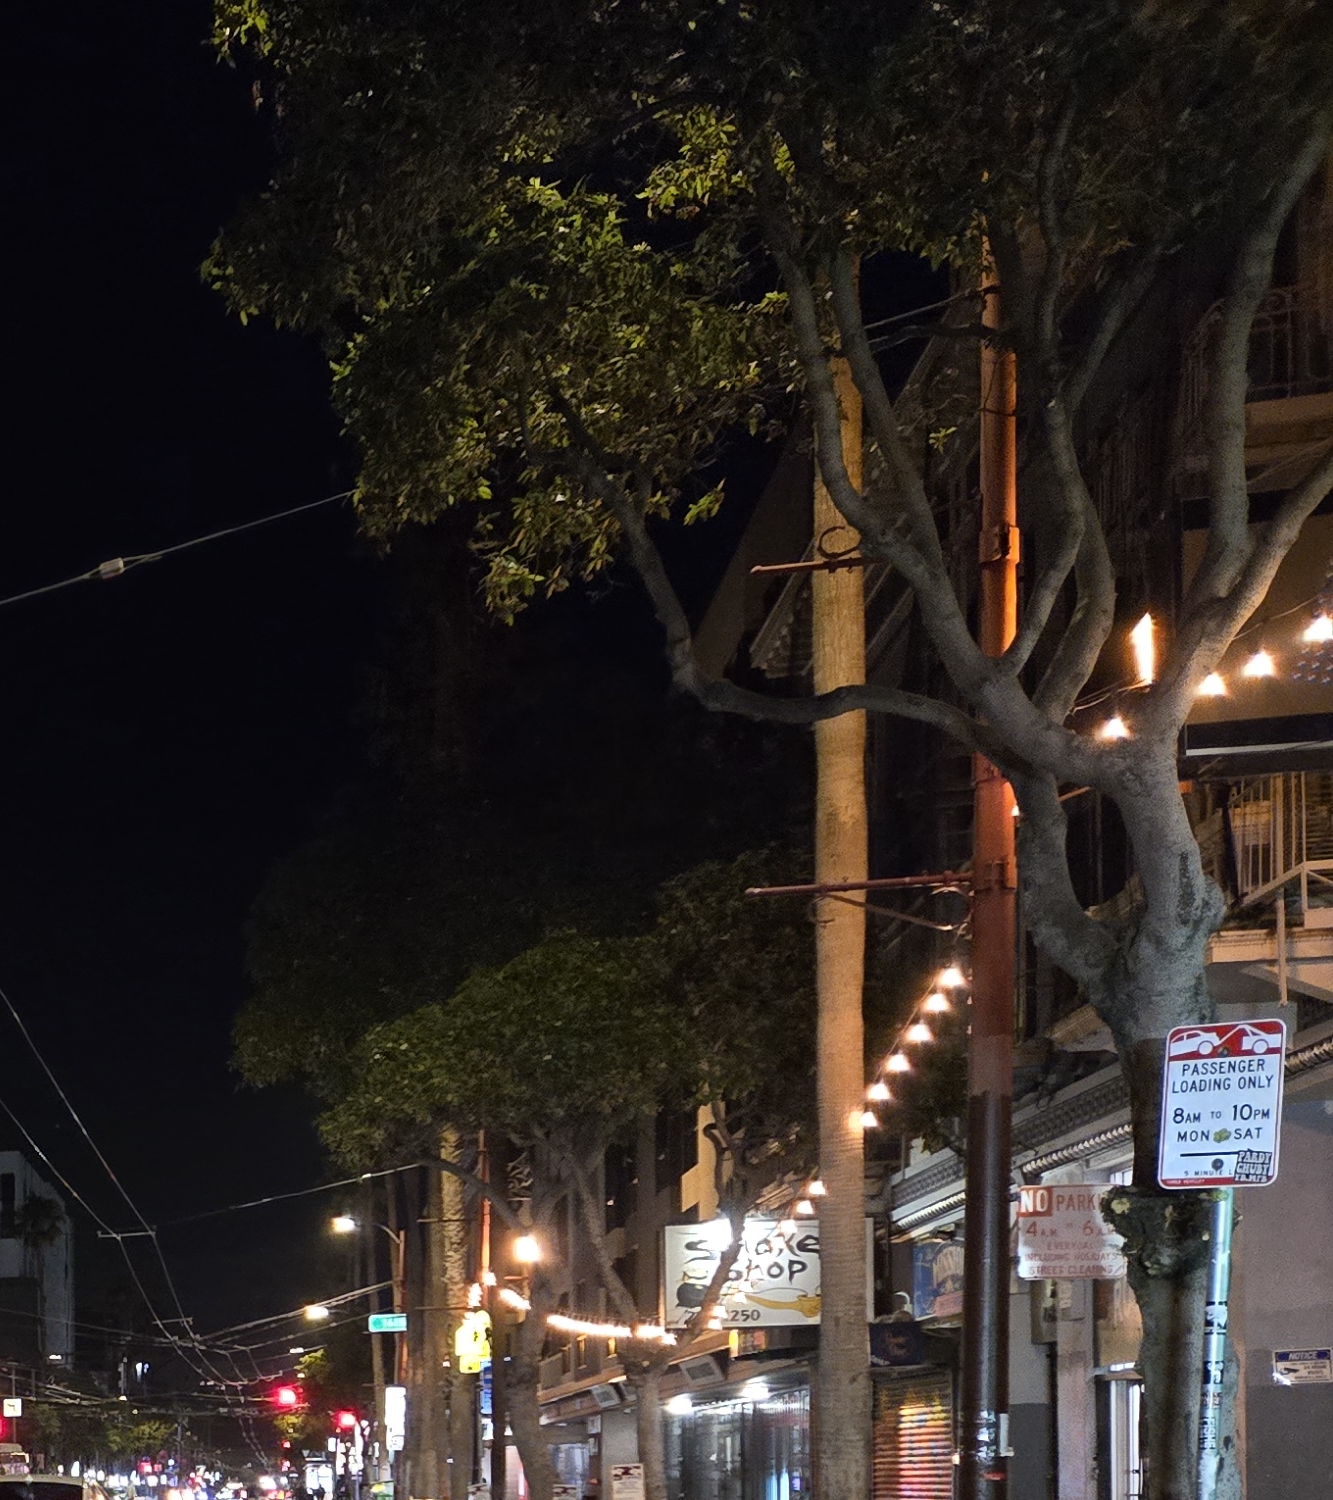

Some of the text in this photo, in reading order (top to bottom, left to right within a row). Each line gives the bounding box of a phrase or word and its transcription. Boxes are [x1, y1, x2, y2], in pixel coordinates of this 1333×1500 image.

[1182, 1059, 1265, 1076] PASSENGER
[1172, 1075, 1274, 1093] LOADING ONLY
[1172, 1104, 1270, 1124] 8AM TO 10PM
[1177, 1127, 1263, 1142] MON SAT
[1020, 1189, 1049, 1212] NO
[1026, 1222, 1037, 1237] 4
[1083, 1221, 1093, 1236] 6
[1288, 1351, 1317, 1360] NOTICE
